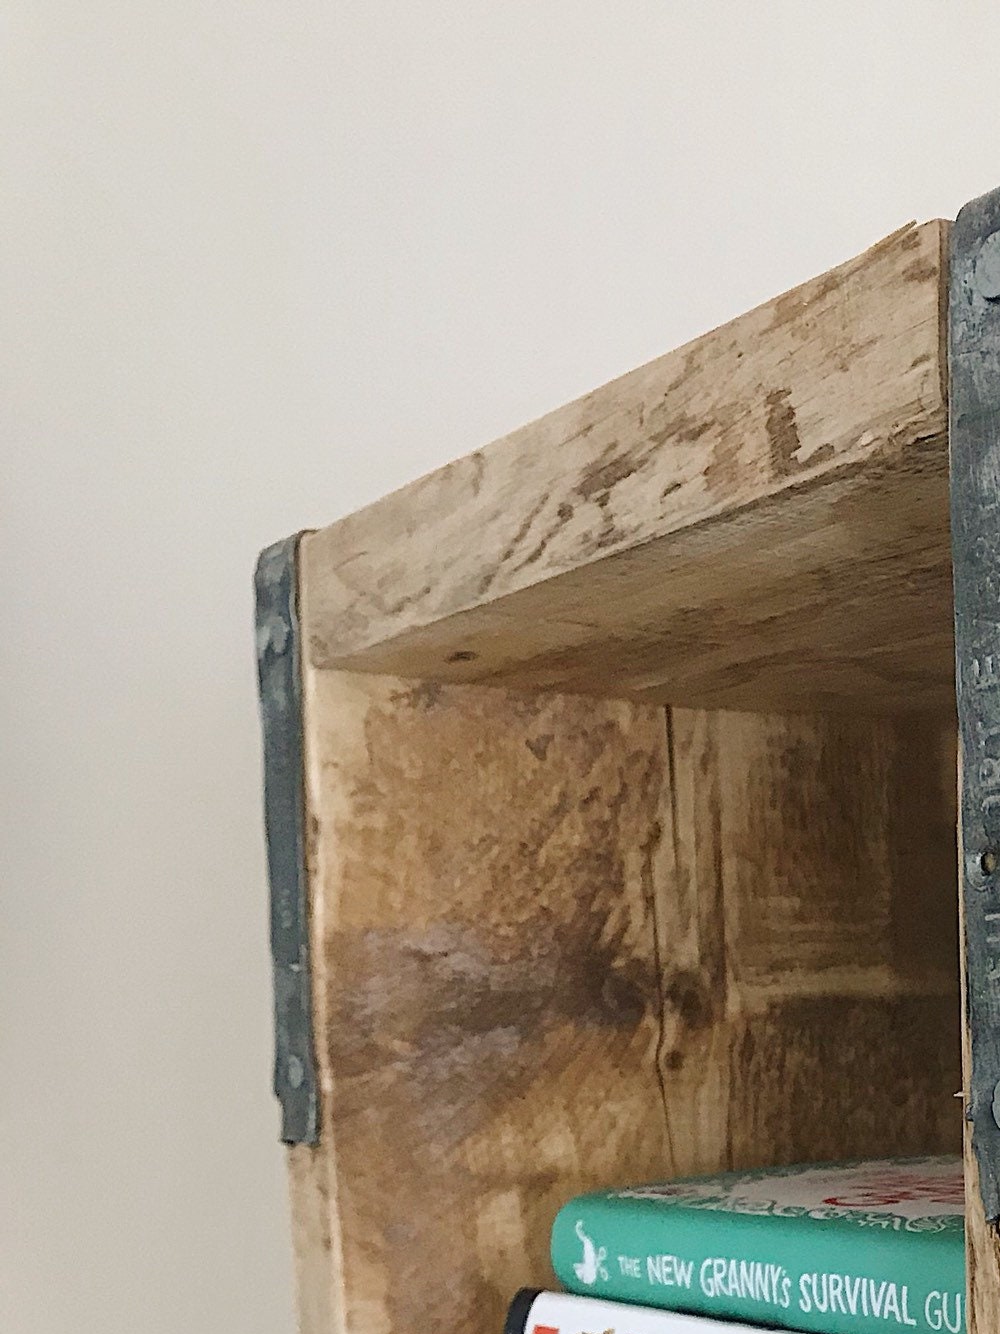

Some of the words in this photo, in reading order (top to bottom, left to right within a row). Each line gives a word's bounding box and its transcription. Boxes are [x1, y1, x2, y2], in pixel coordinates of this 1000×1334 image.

[618, 1255, 641, 1278] THE
[647, 1254, 694, 1289] NEW
[799, 1273, 917, 1326] SURVIVAL
